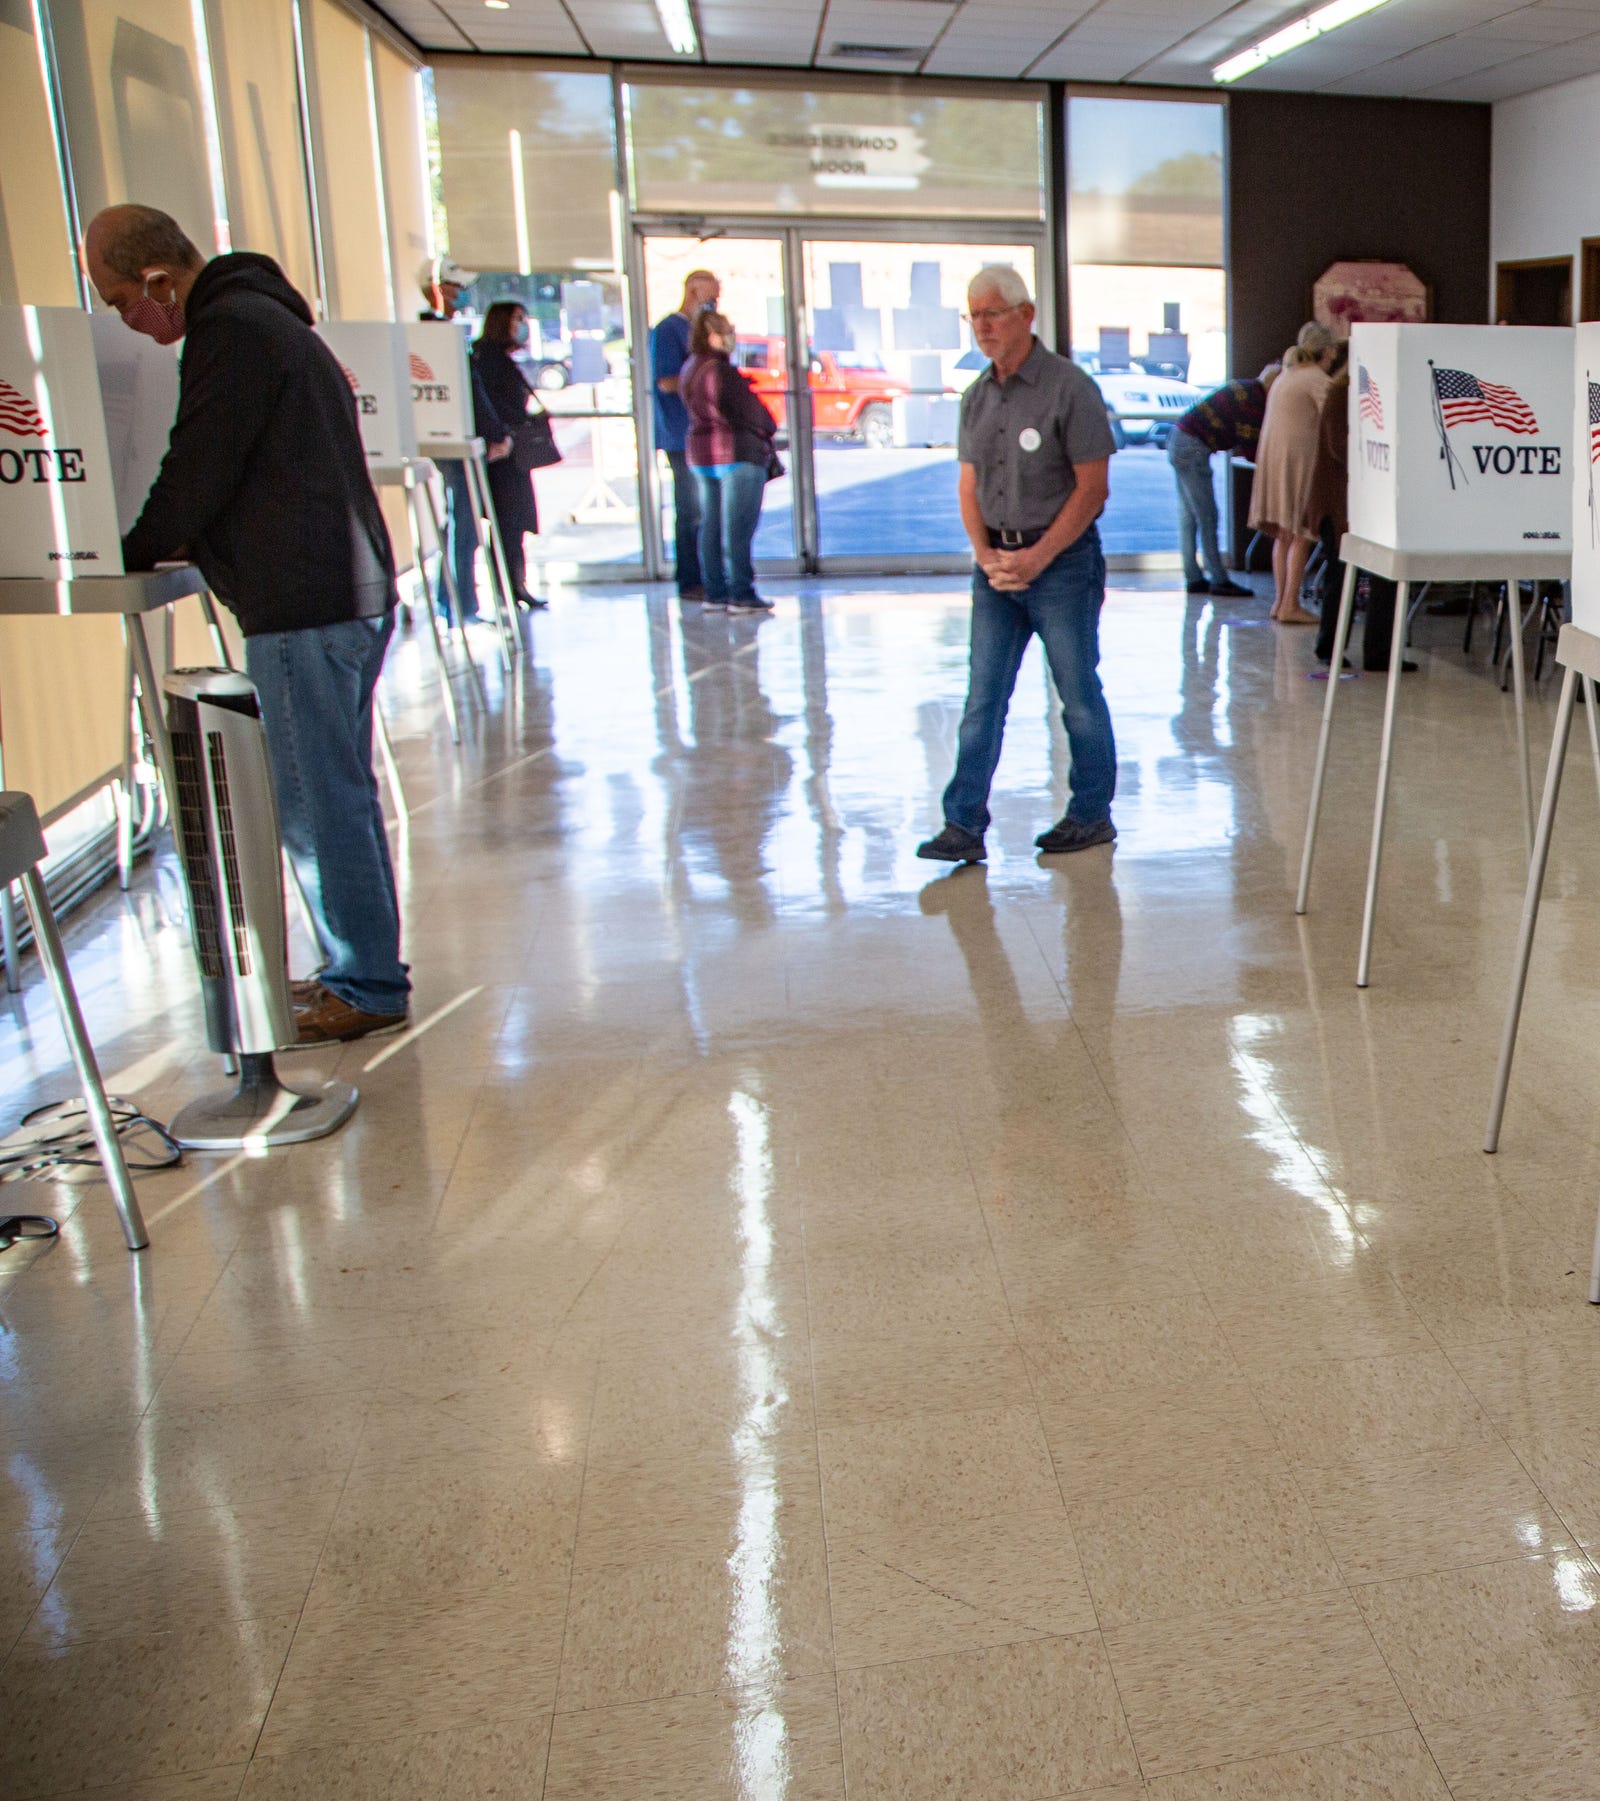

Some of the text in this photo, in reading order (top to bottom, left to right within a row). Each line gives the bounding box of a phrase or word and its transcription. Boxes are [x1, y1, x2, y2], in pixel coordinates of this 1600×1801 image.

[0, 448, 86, 484] OTE
[1366, 439, 1390, 472] VOTE
[1473, 446, 1561, 475] VOTE
